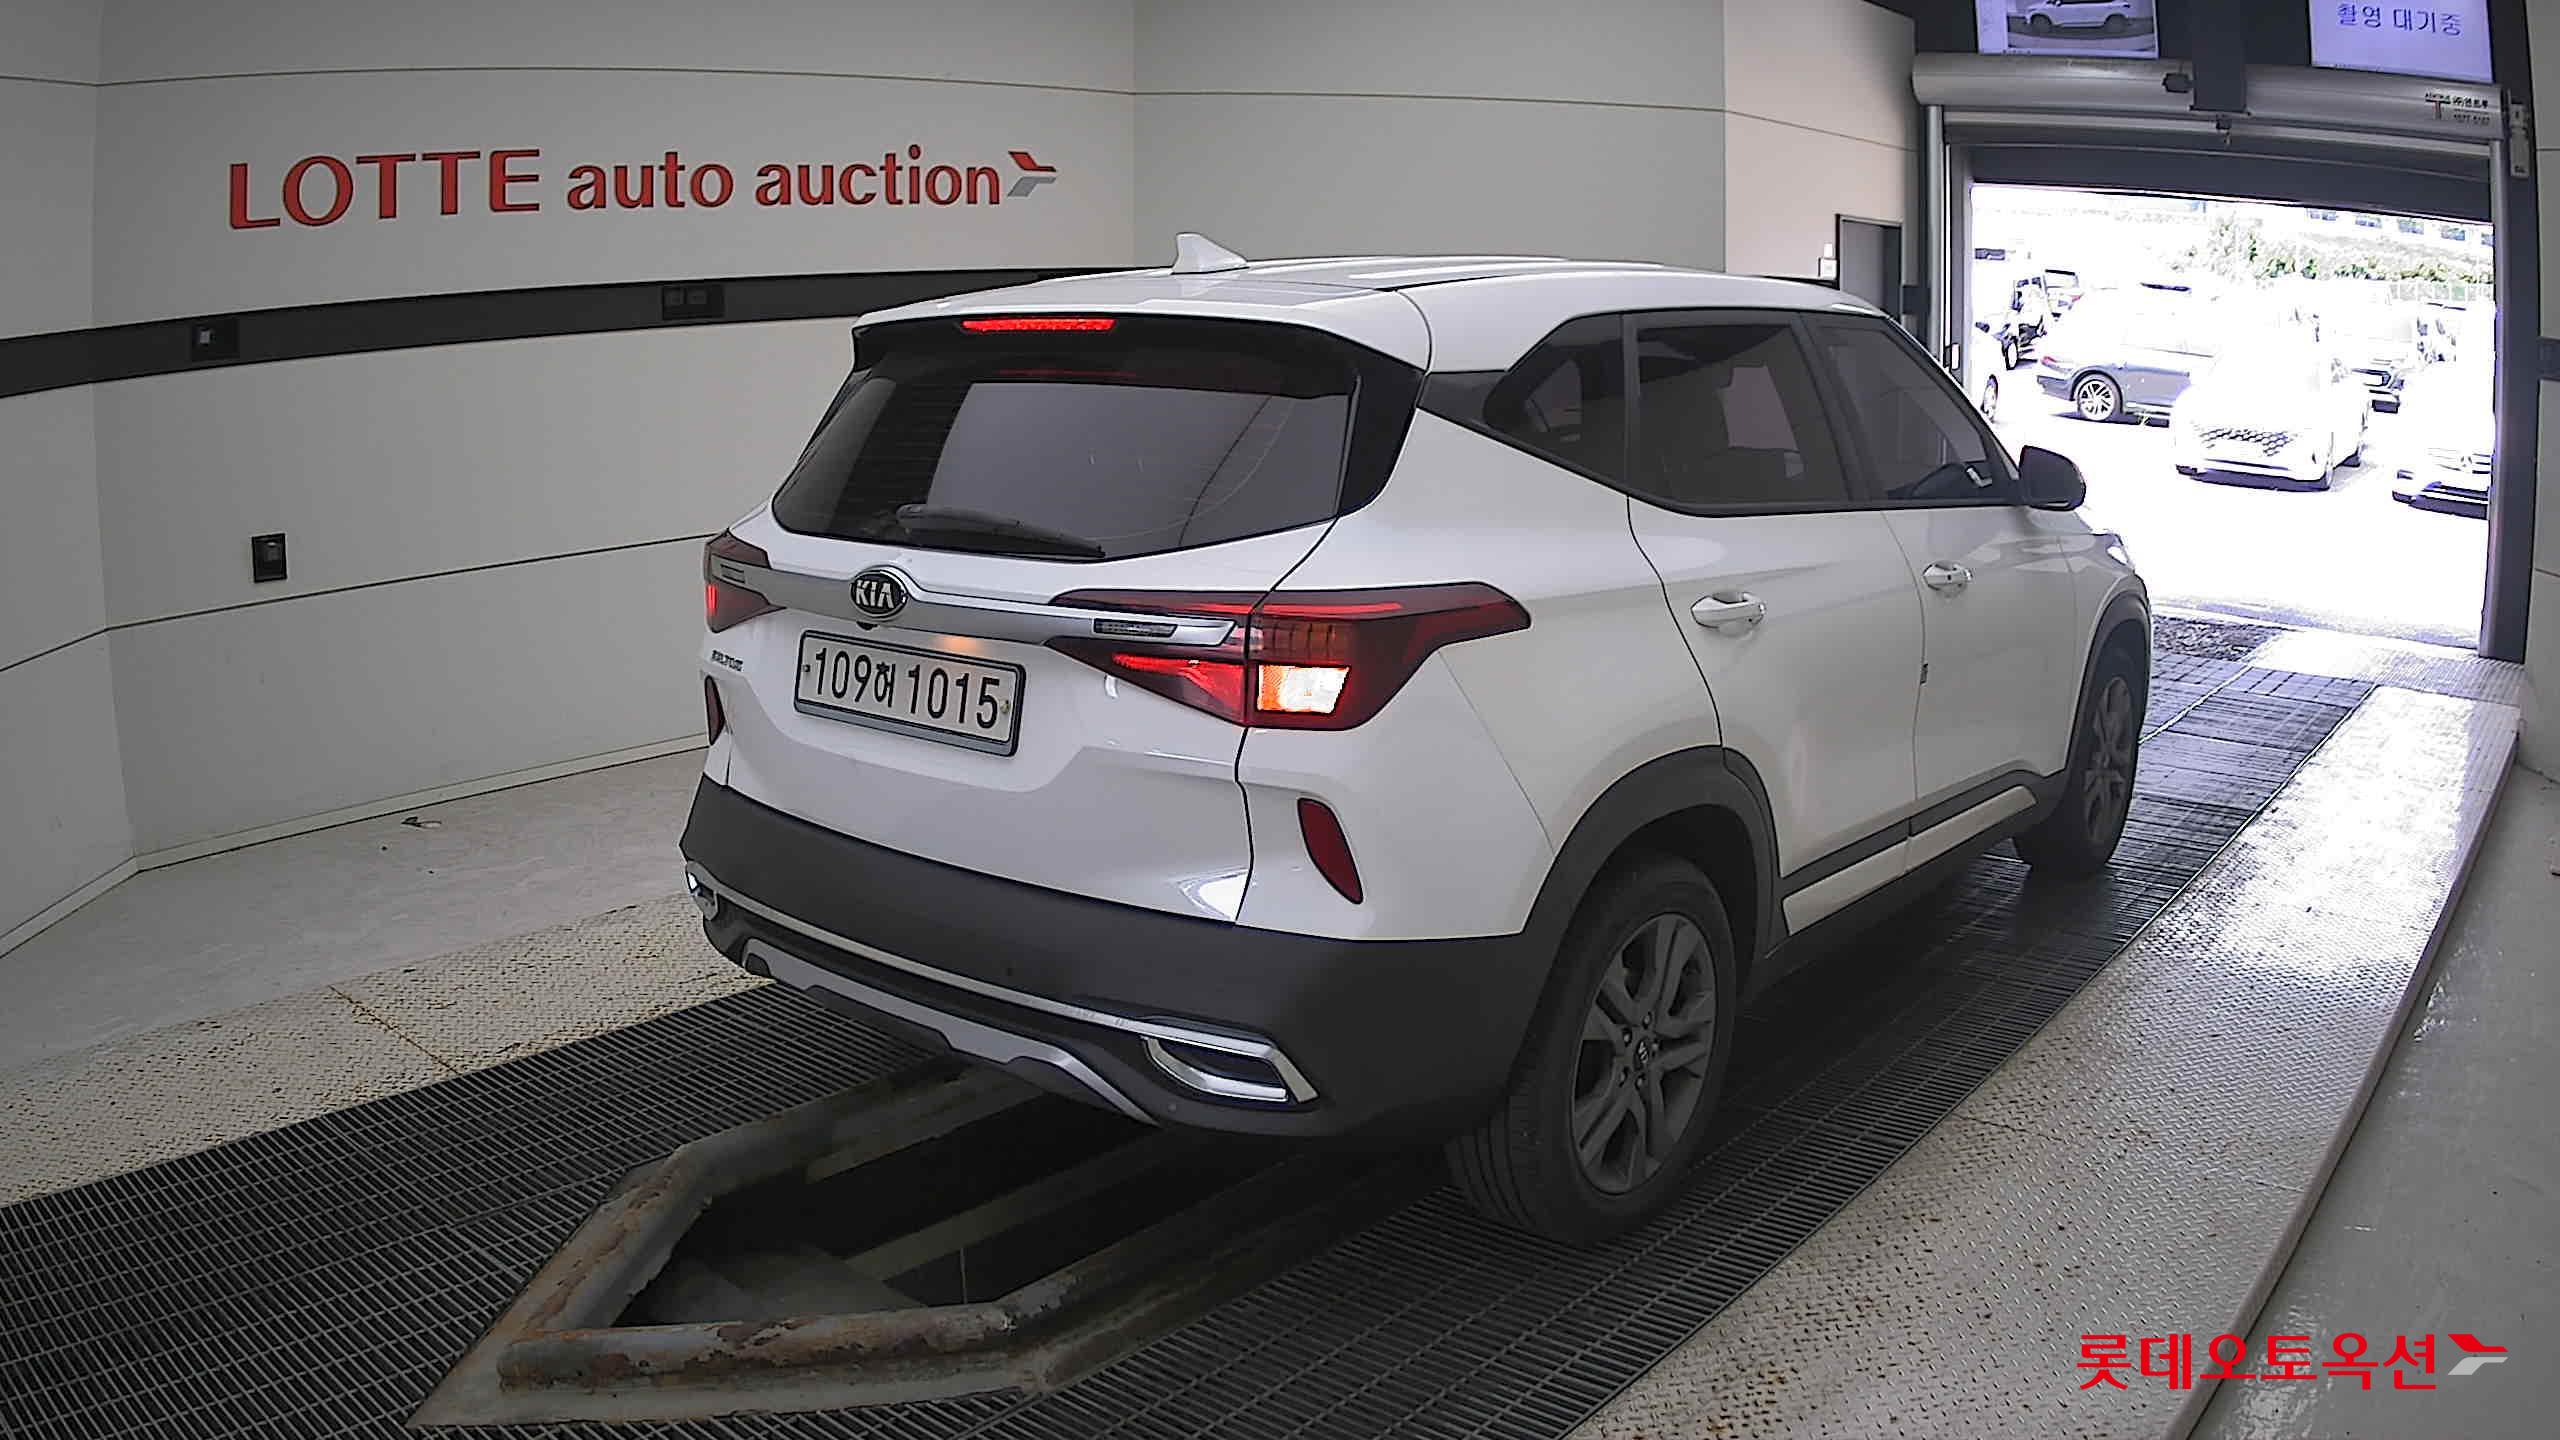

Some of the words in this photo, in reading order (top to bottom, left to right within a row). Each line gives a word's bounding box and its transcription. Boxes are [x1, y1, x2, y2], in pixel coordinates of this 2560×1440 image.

[2337, 3, 2382, 29] 촬영
[2392, 8, 2462, 37] 대기중
[229, 149, 540, 231] LOTTE
[567, 152, 736, 210] auto
[754, 145, 1004, 208] auction
[856, 579, 895, 609] KIA
[814, 647, 897, 708] 109허
[907, 663, 1001, 729] 1015
